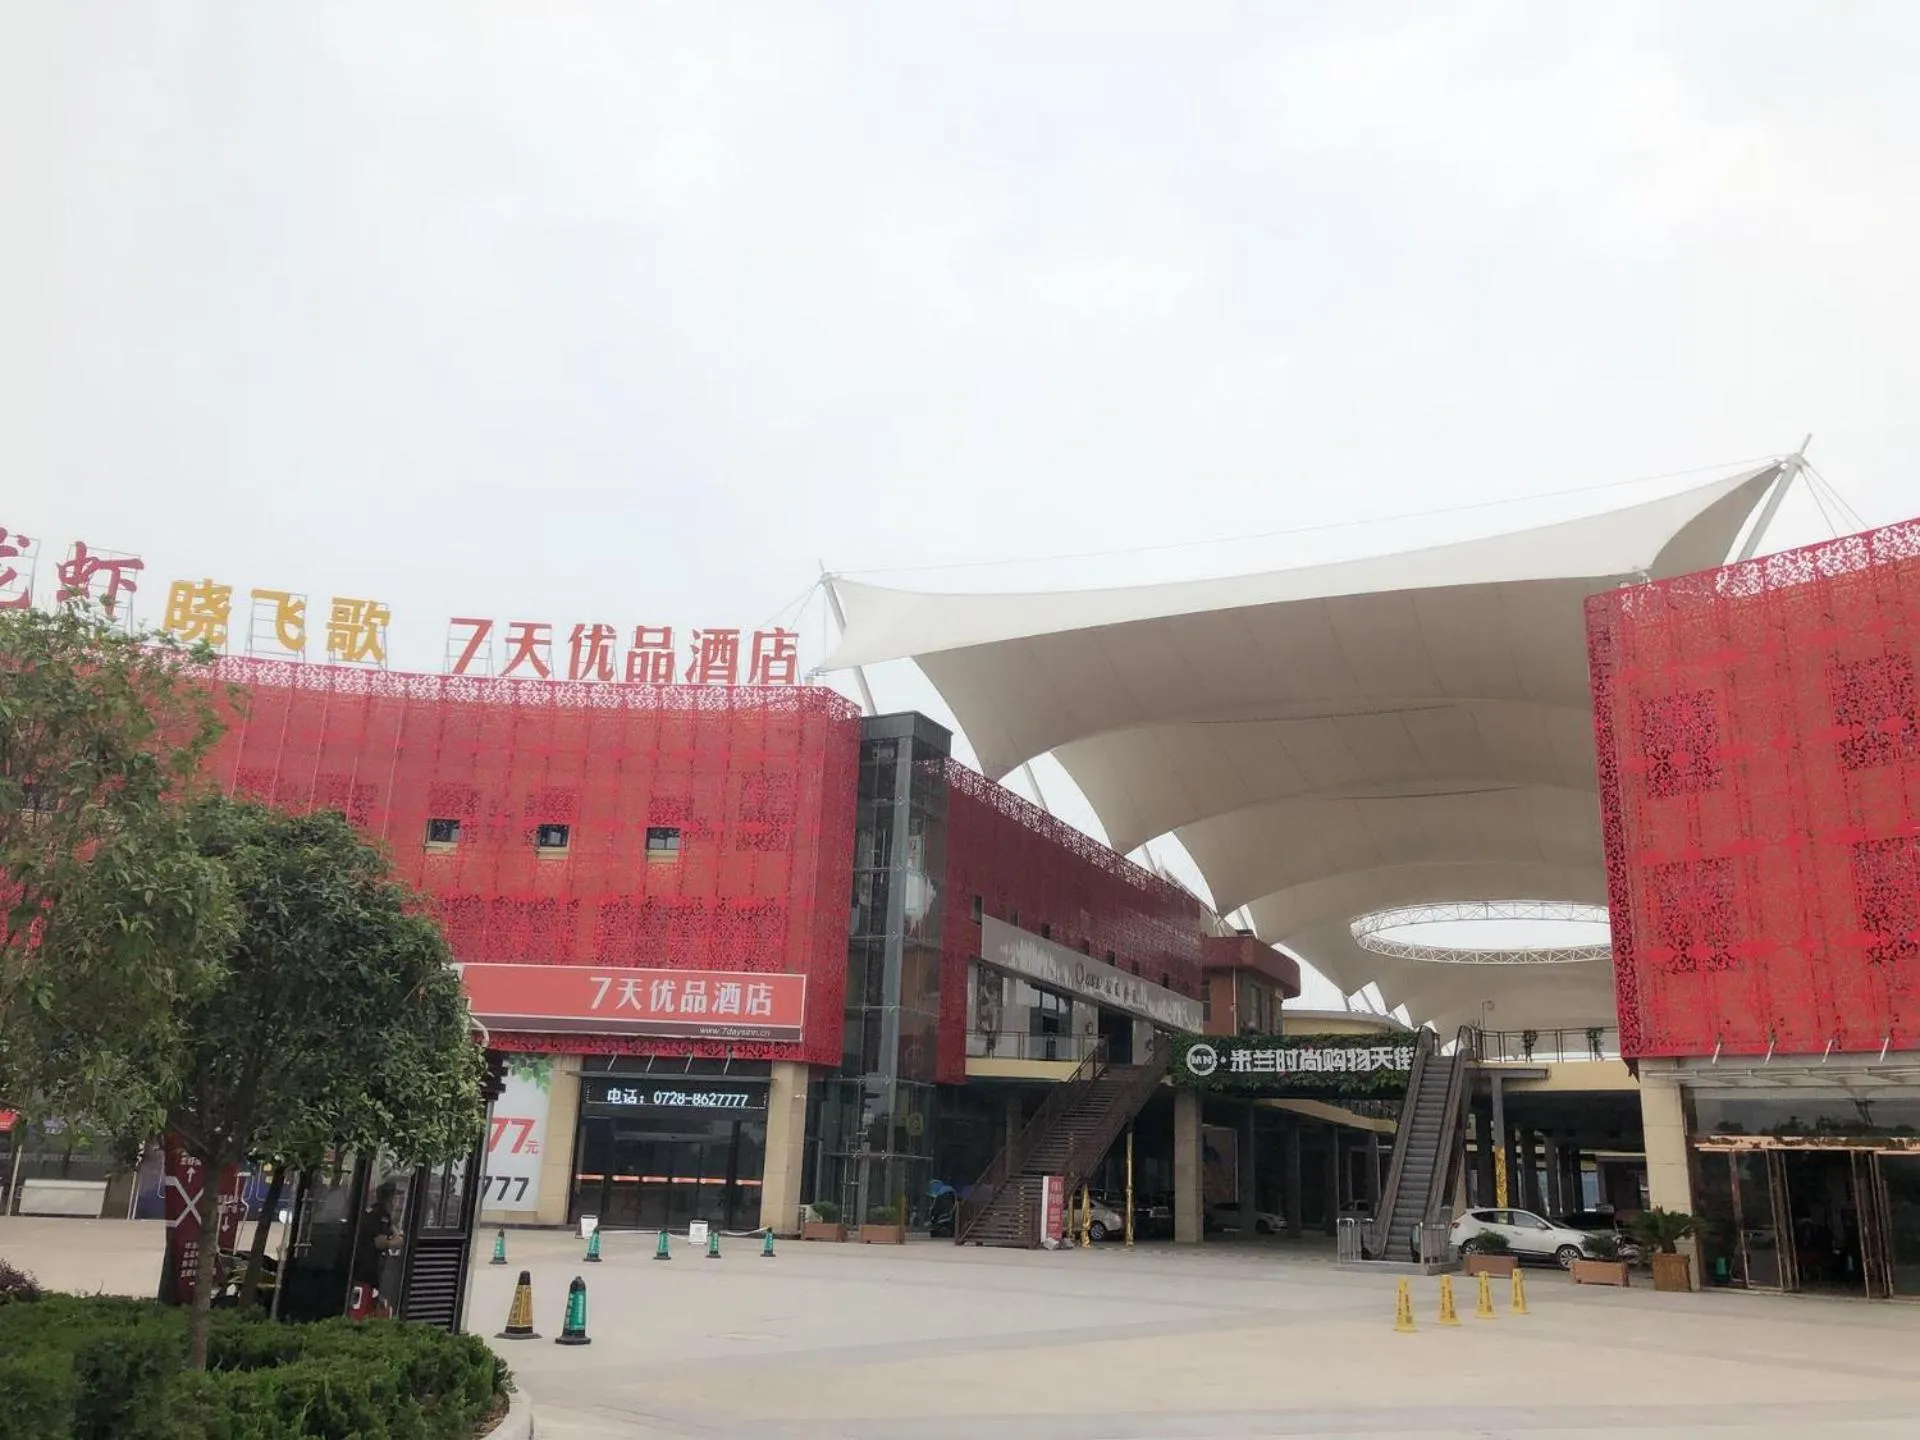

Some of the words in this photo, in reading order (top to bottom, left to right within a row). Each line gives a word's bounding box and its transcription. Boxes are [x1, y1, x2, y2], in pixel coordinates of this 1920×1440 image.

[163, 579, 391, 661] 晓飞歌
[450, 617, 799, 685] 7天优品酒店
[589, 976, 774, 1016] 7天优品酒店
